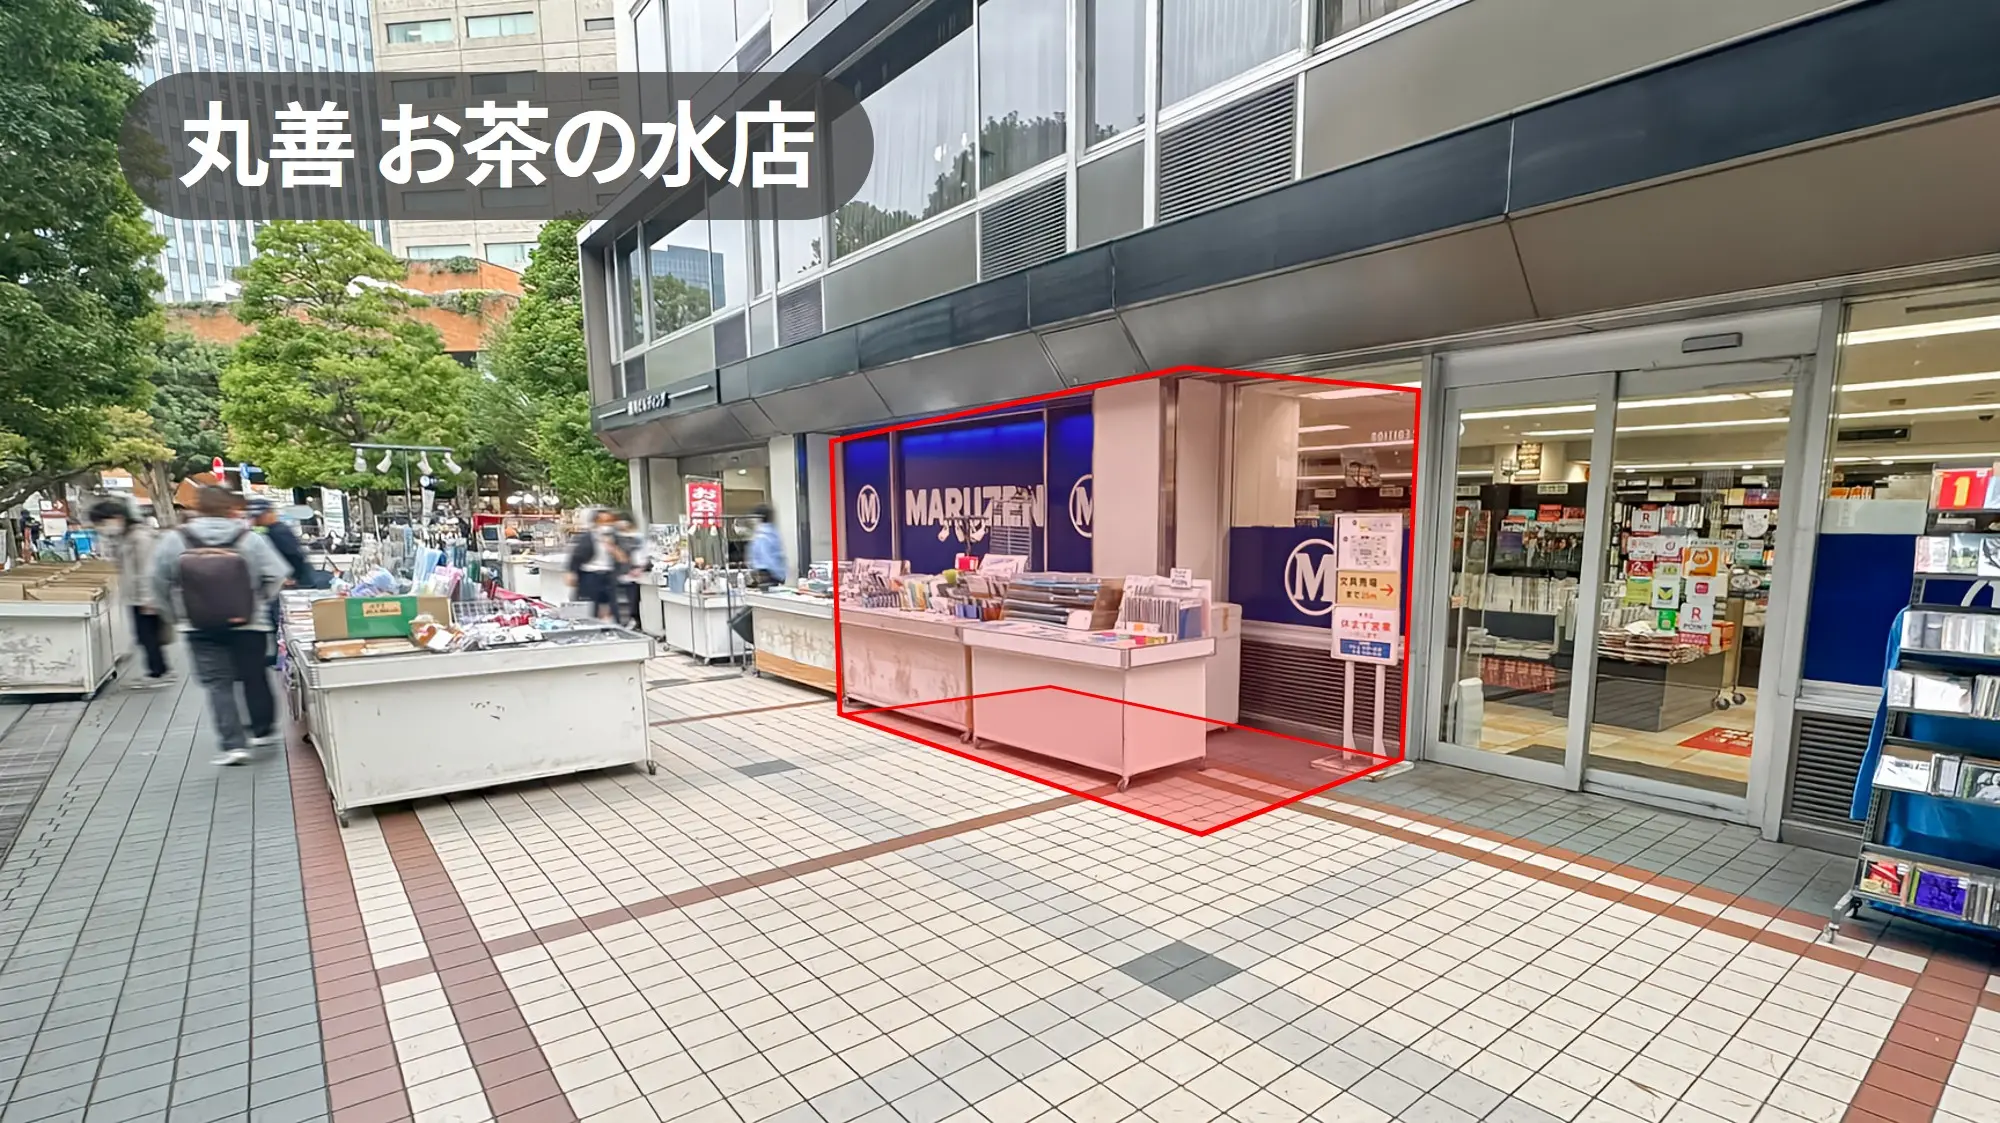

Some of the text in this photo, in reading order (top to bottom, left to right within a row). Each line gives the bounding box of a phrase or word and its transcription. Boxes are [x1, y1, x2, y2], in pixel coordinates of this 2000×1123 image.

[905, 484, 1045, 528] MARUZEN
[1294, 553, 1334, 602] M
[1340, 577, 1377, 588] 文具売場
